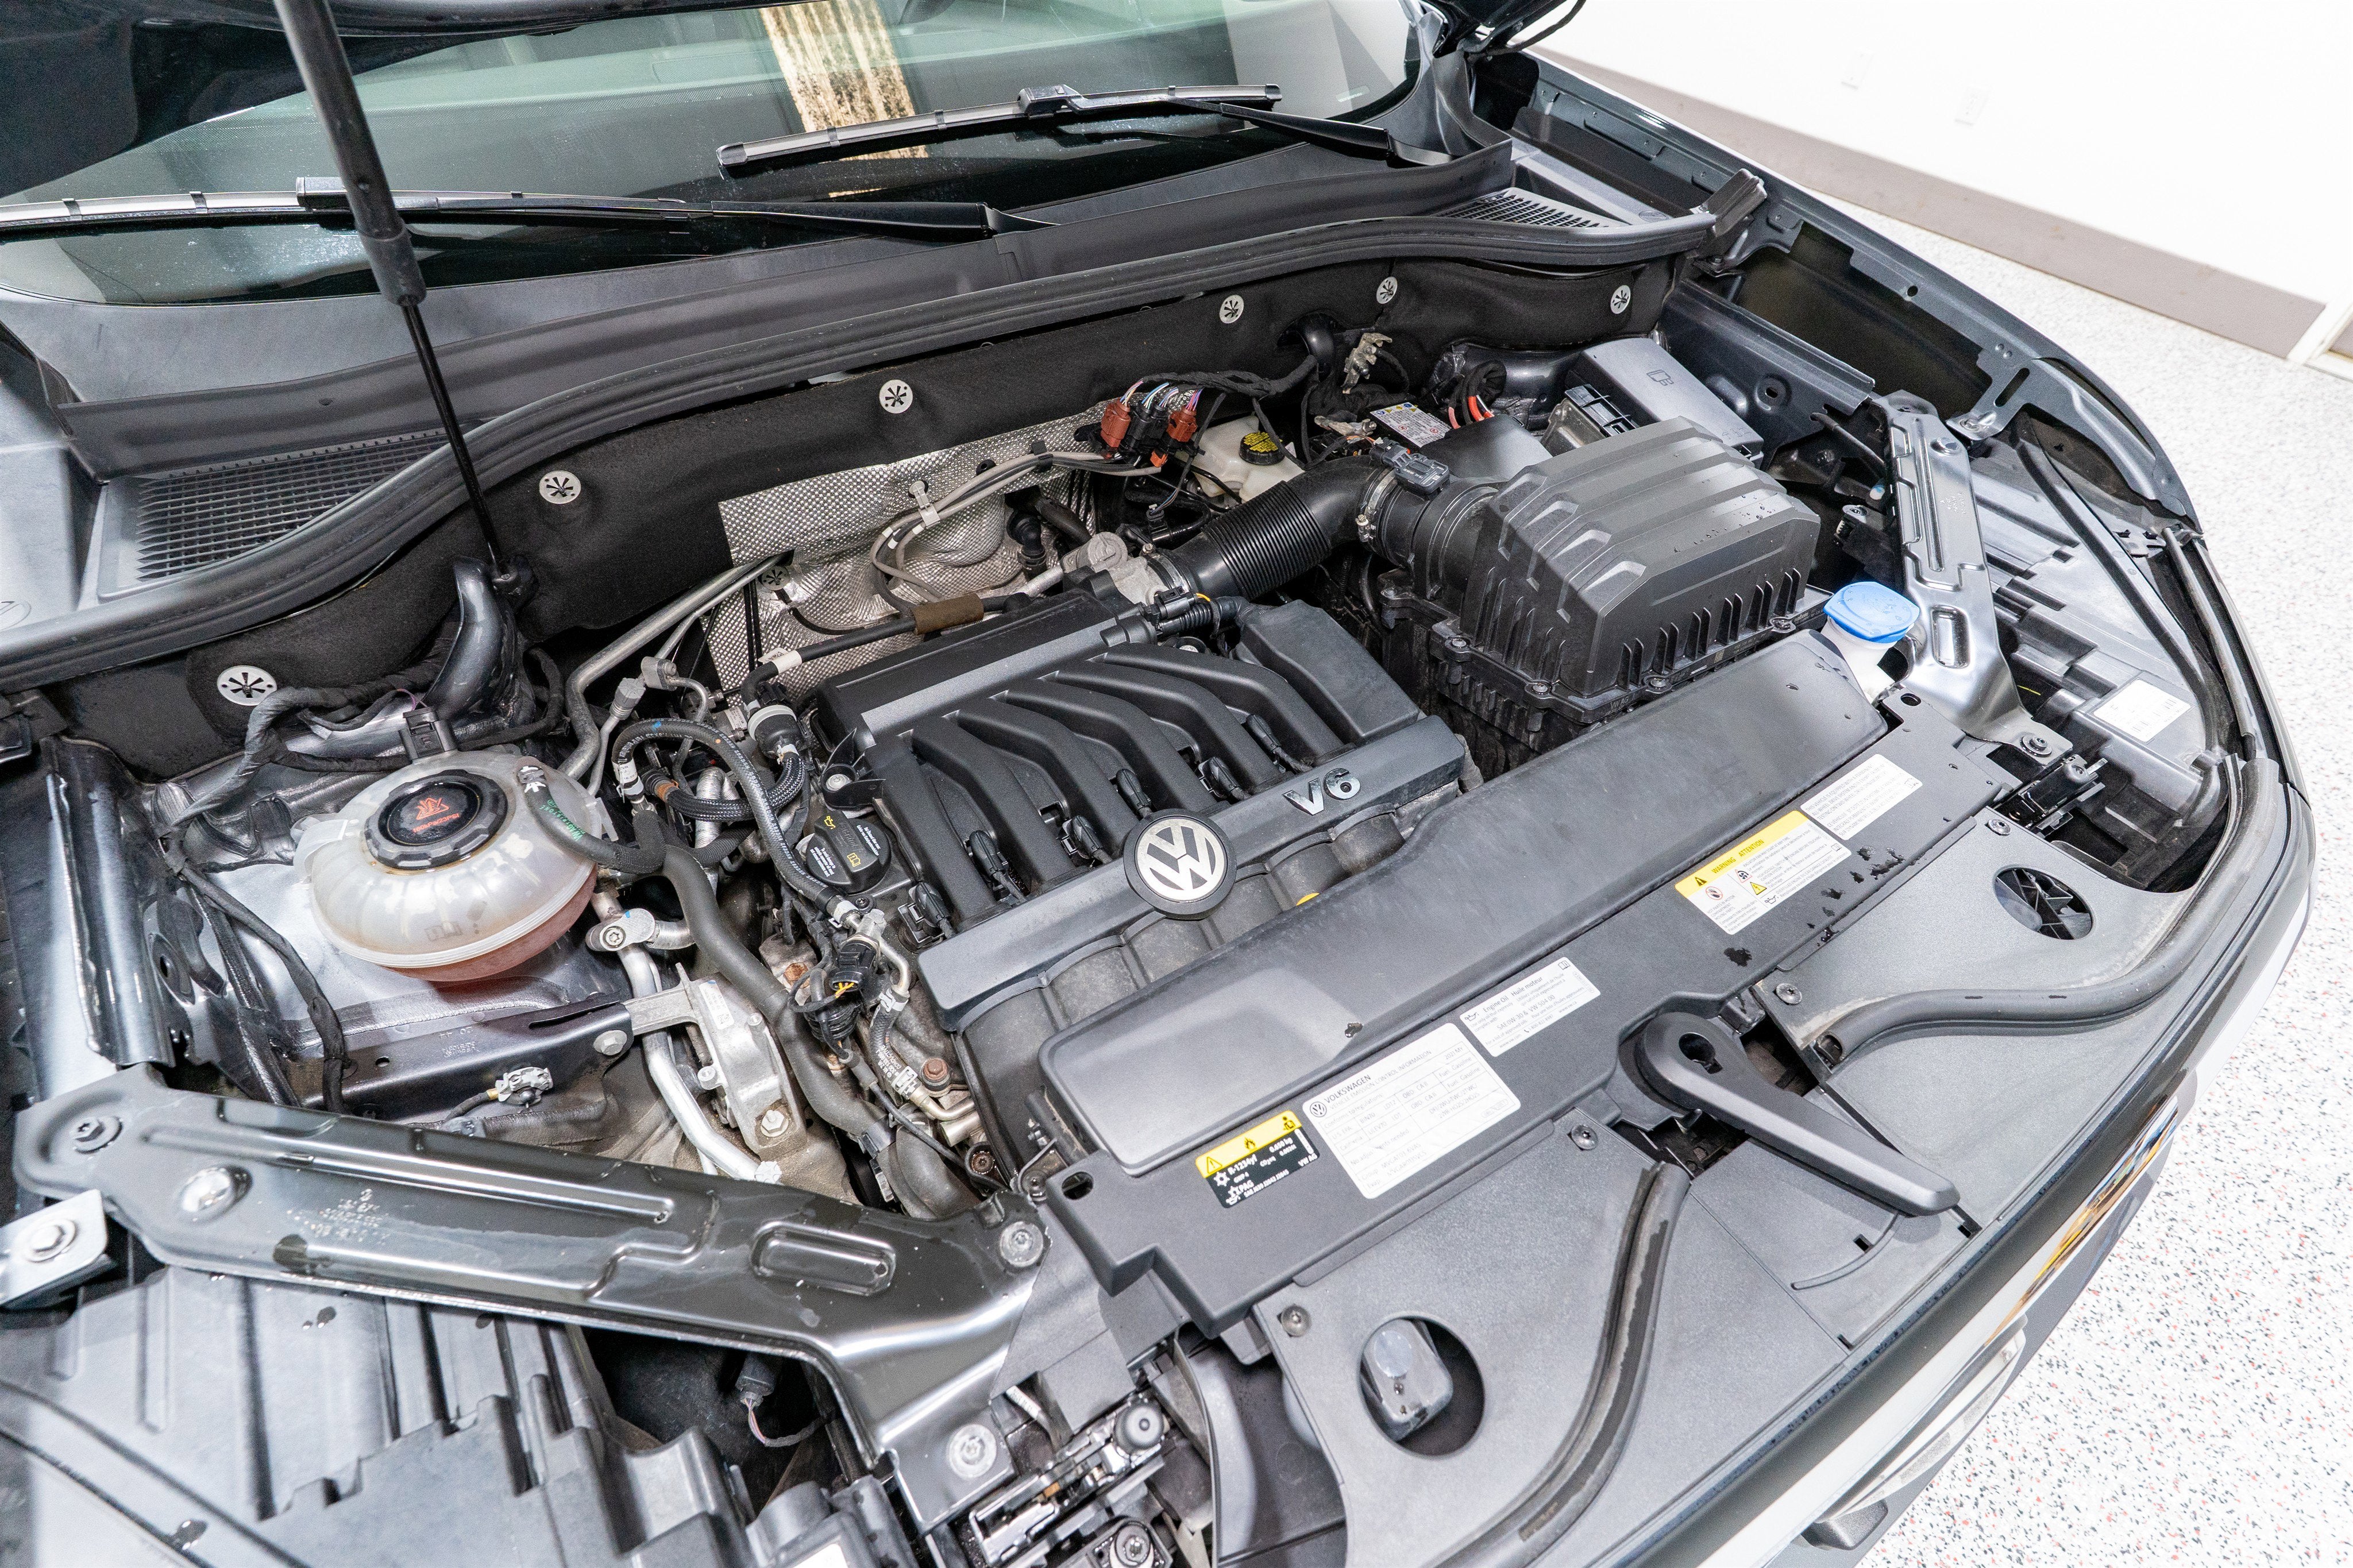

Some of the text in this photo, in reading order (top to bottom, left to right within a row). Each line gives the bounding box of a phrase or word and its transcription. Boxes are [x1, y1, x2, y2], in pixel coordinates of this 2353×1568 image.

[1283, 767, 1361, 816] V6
[1812, 795, 1827, 806] VEHICLE
[1828, 783, 1847, 796] EQUIPPED
[1843, 777, 1854, 785] WITH
[1827, 795, 1839, 804] DRIVE
[1816, 809, 1833, 821] TESTING
[1710, 839, 1765, 874] WARNING ATTENTION
[1510, 976, 1544, 997] Huile moteur
[1482, 995, 1509, 1014] Engine Oil
[1527, 1003, 1539, 1013] VW
[1537, 998, 1549, 1007] 504
[1496, 1021, 1508, 1030] SAE
[1505, 1012, 1524, 1025] 0W-30
[1443, 1045, 1464, 1060] 2021 MY
[1450, 1055, 1472, 1071] Gasoline
[1329, 1049, 1432, 1110] VEHICLE EMISSION CONTROL INFORMATION
[1459, 1065, 1481, 1081] Gasoline
[1324, 1073, 1372, 1104] VOLKSWAGEN
[1415, 1083, 1425, 1091] CA
[1424, 1093, 1433, 1102] CA
[1323, 1111, 1349, 1129] Conforms
[1226, 1153, 1259, 1176] R-1234yf
[1282, 1135, 1294, 1146] kg
[1297, 1152, 1318, 1167] VW AG
[1349, 1157, 1360, 1166] No
[1237, 1179, 1255, 1193] PAG
